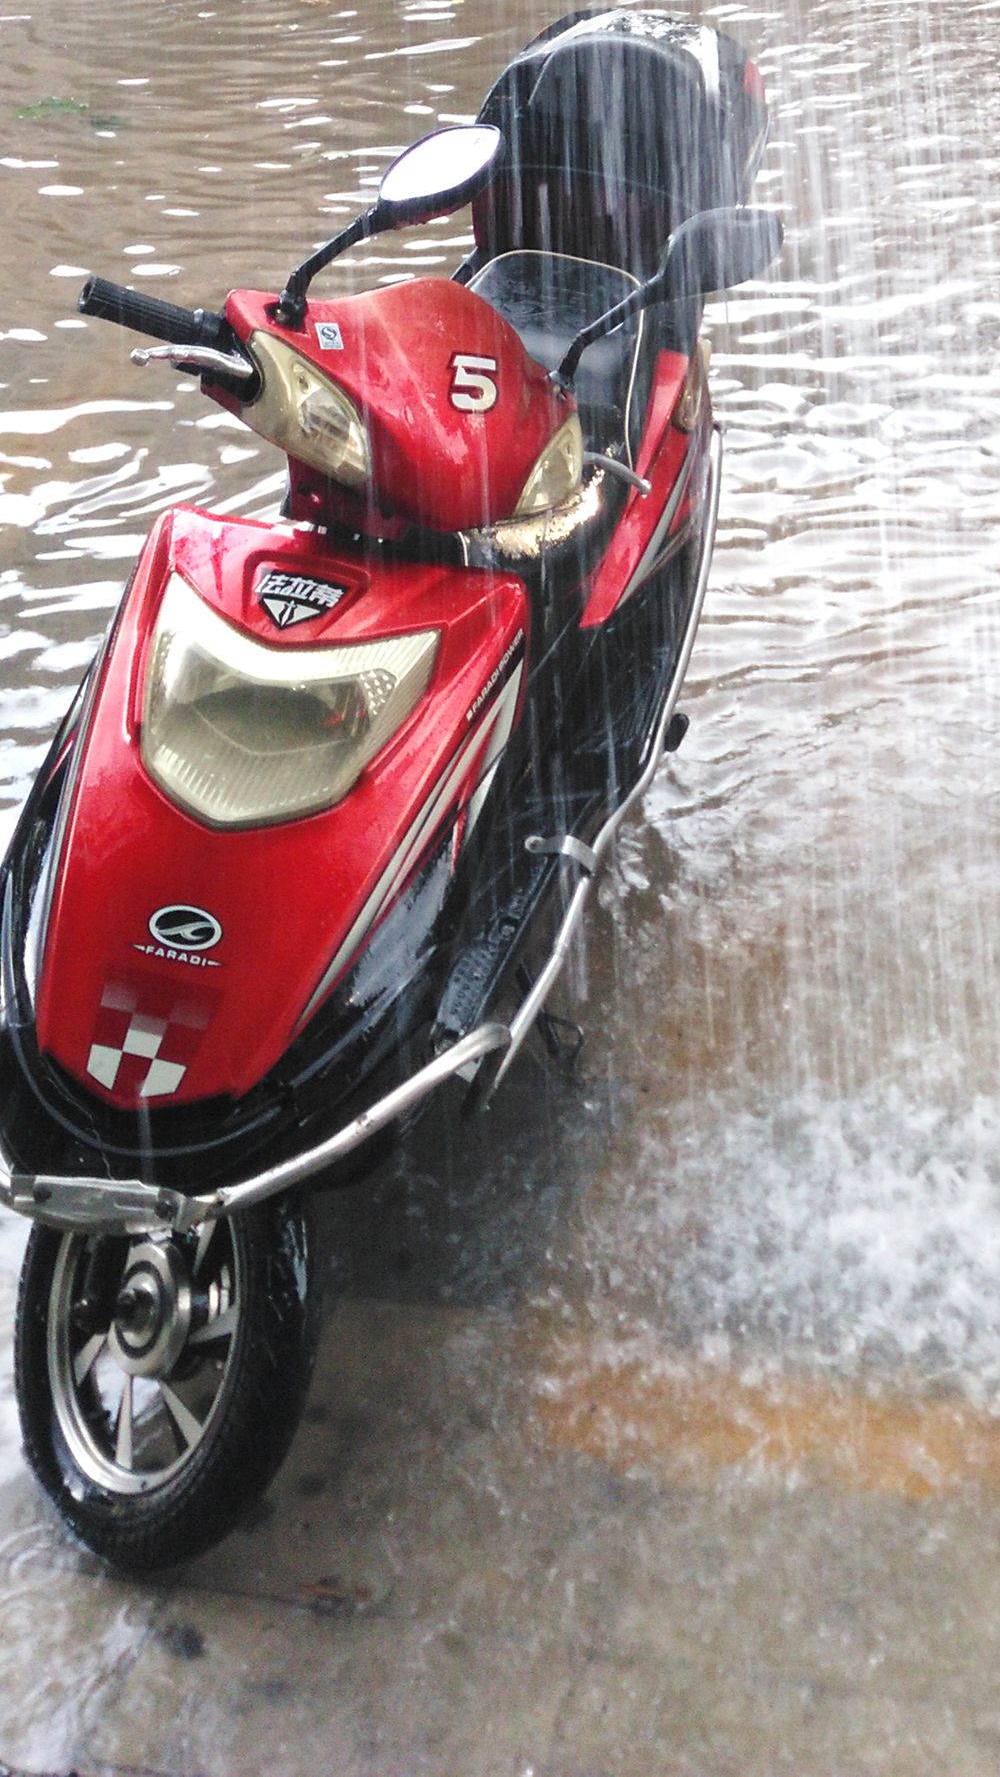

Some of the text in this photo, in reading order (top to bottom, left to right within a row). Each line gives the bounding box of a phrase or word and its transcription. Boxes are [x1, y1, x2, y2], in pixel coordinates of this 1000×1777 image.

[449, 352, 498, 412] 5
[255, 574, 344, 608] 法拉蒂
[146, 945, 207, 967] FARADI
